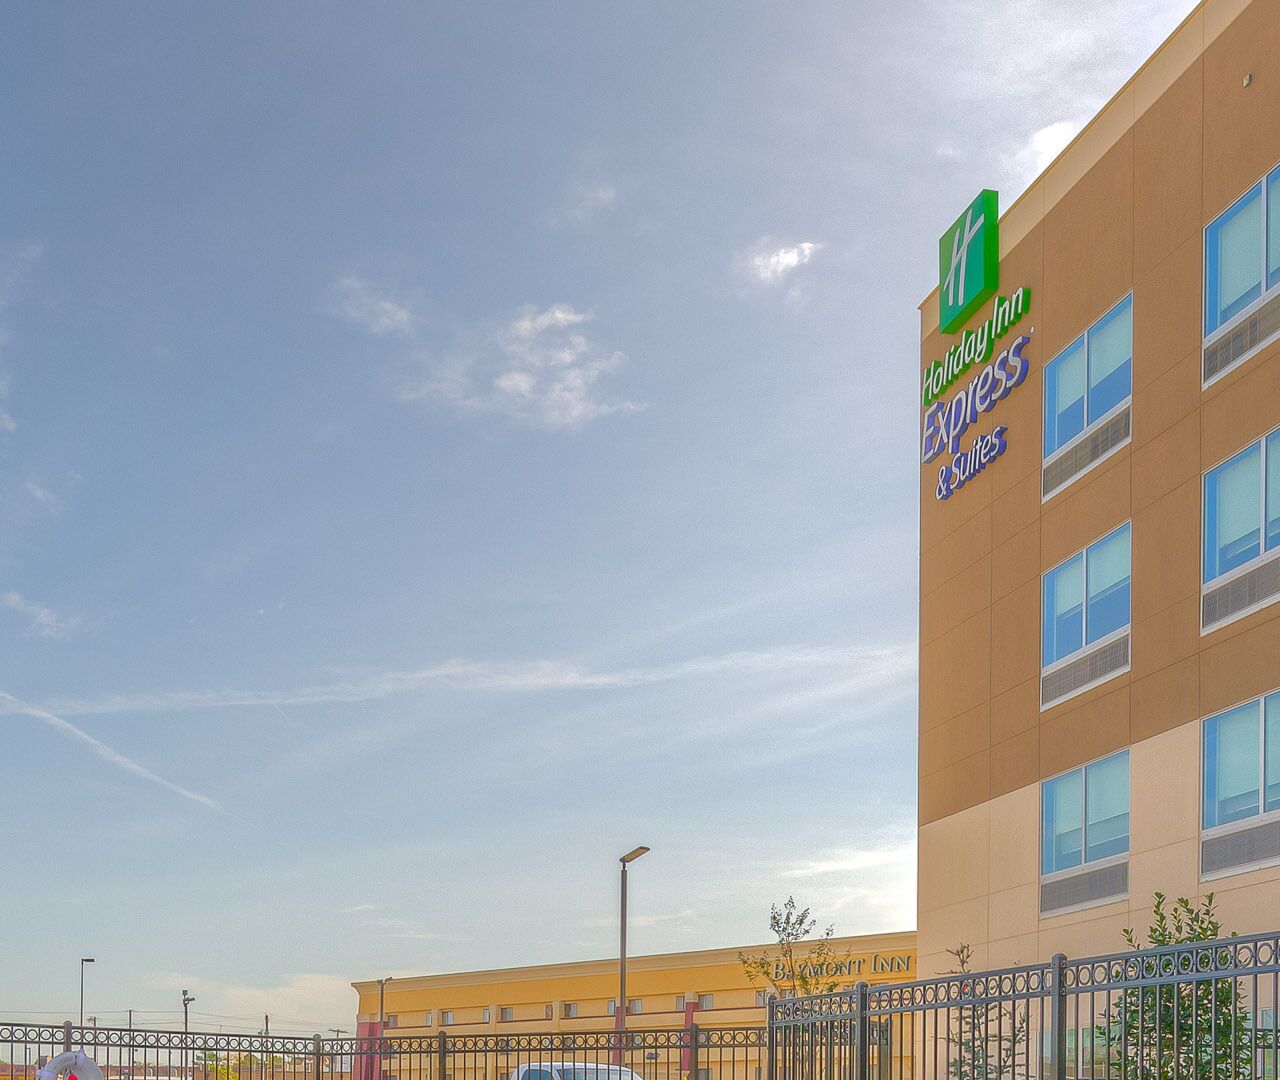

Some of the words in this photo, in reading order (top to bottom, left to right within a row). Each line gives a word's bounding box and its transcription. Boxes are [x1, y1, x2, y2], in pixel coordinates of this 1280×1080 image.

[922, 319, 991, 406] Holiday
[992, 287, 1027, 339] Inn
[921, 335, 1028, 463] Express
[935, 465, 951, 500] &
[950, 427, 1005, 490] Suites
[871, 953, 911, 973] INN
